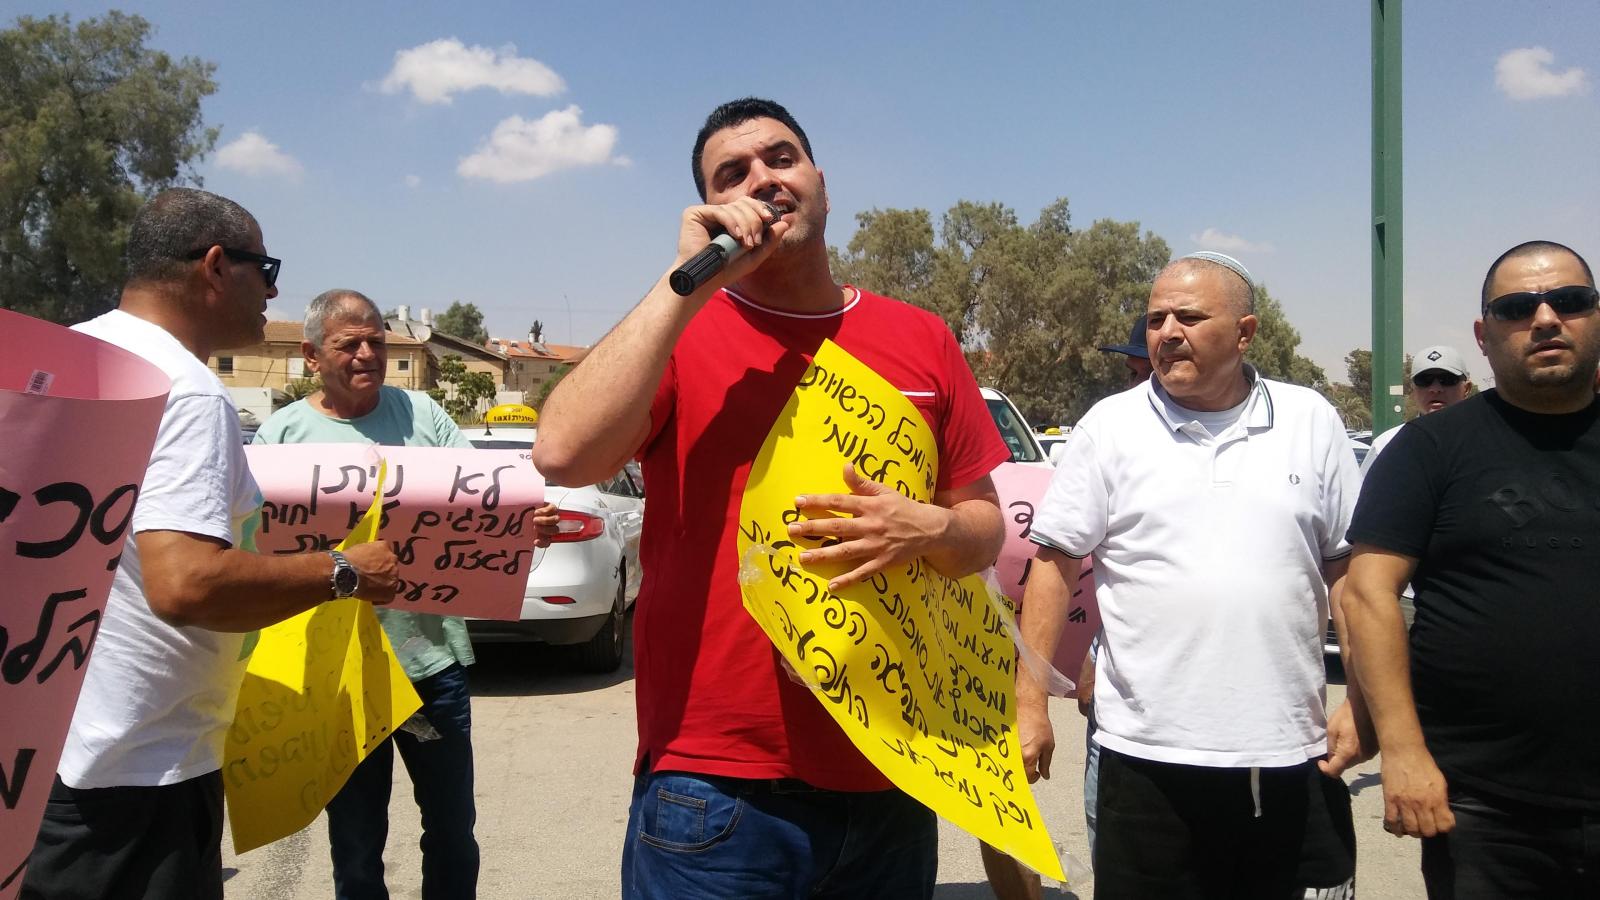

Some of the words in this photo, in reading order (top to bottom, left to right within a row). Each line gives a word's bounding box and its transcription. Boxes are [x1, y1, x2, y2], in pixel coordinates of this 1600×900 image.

[310, 465, 404, 515] ניתן
[448, 465, 516, 511] לא
[411, 507, 536, 538] לנהגים
[1502, 536, 1585, 549] HUGO
